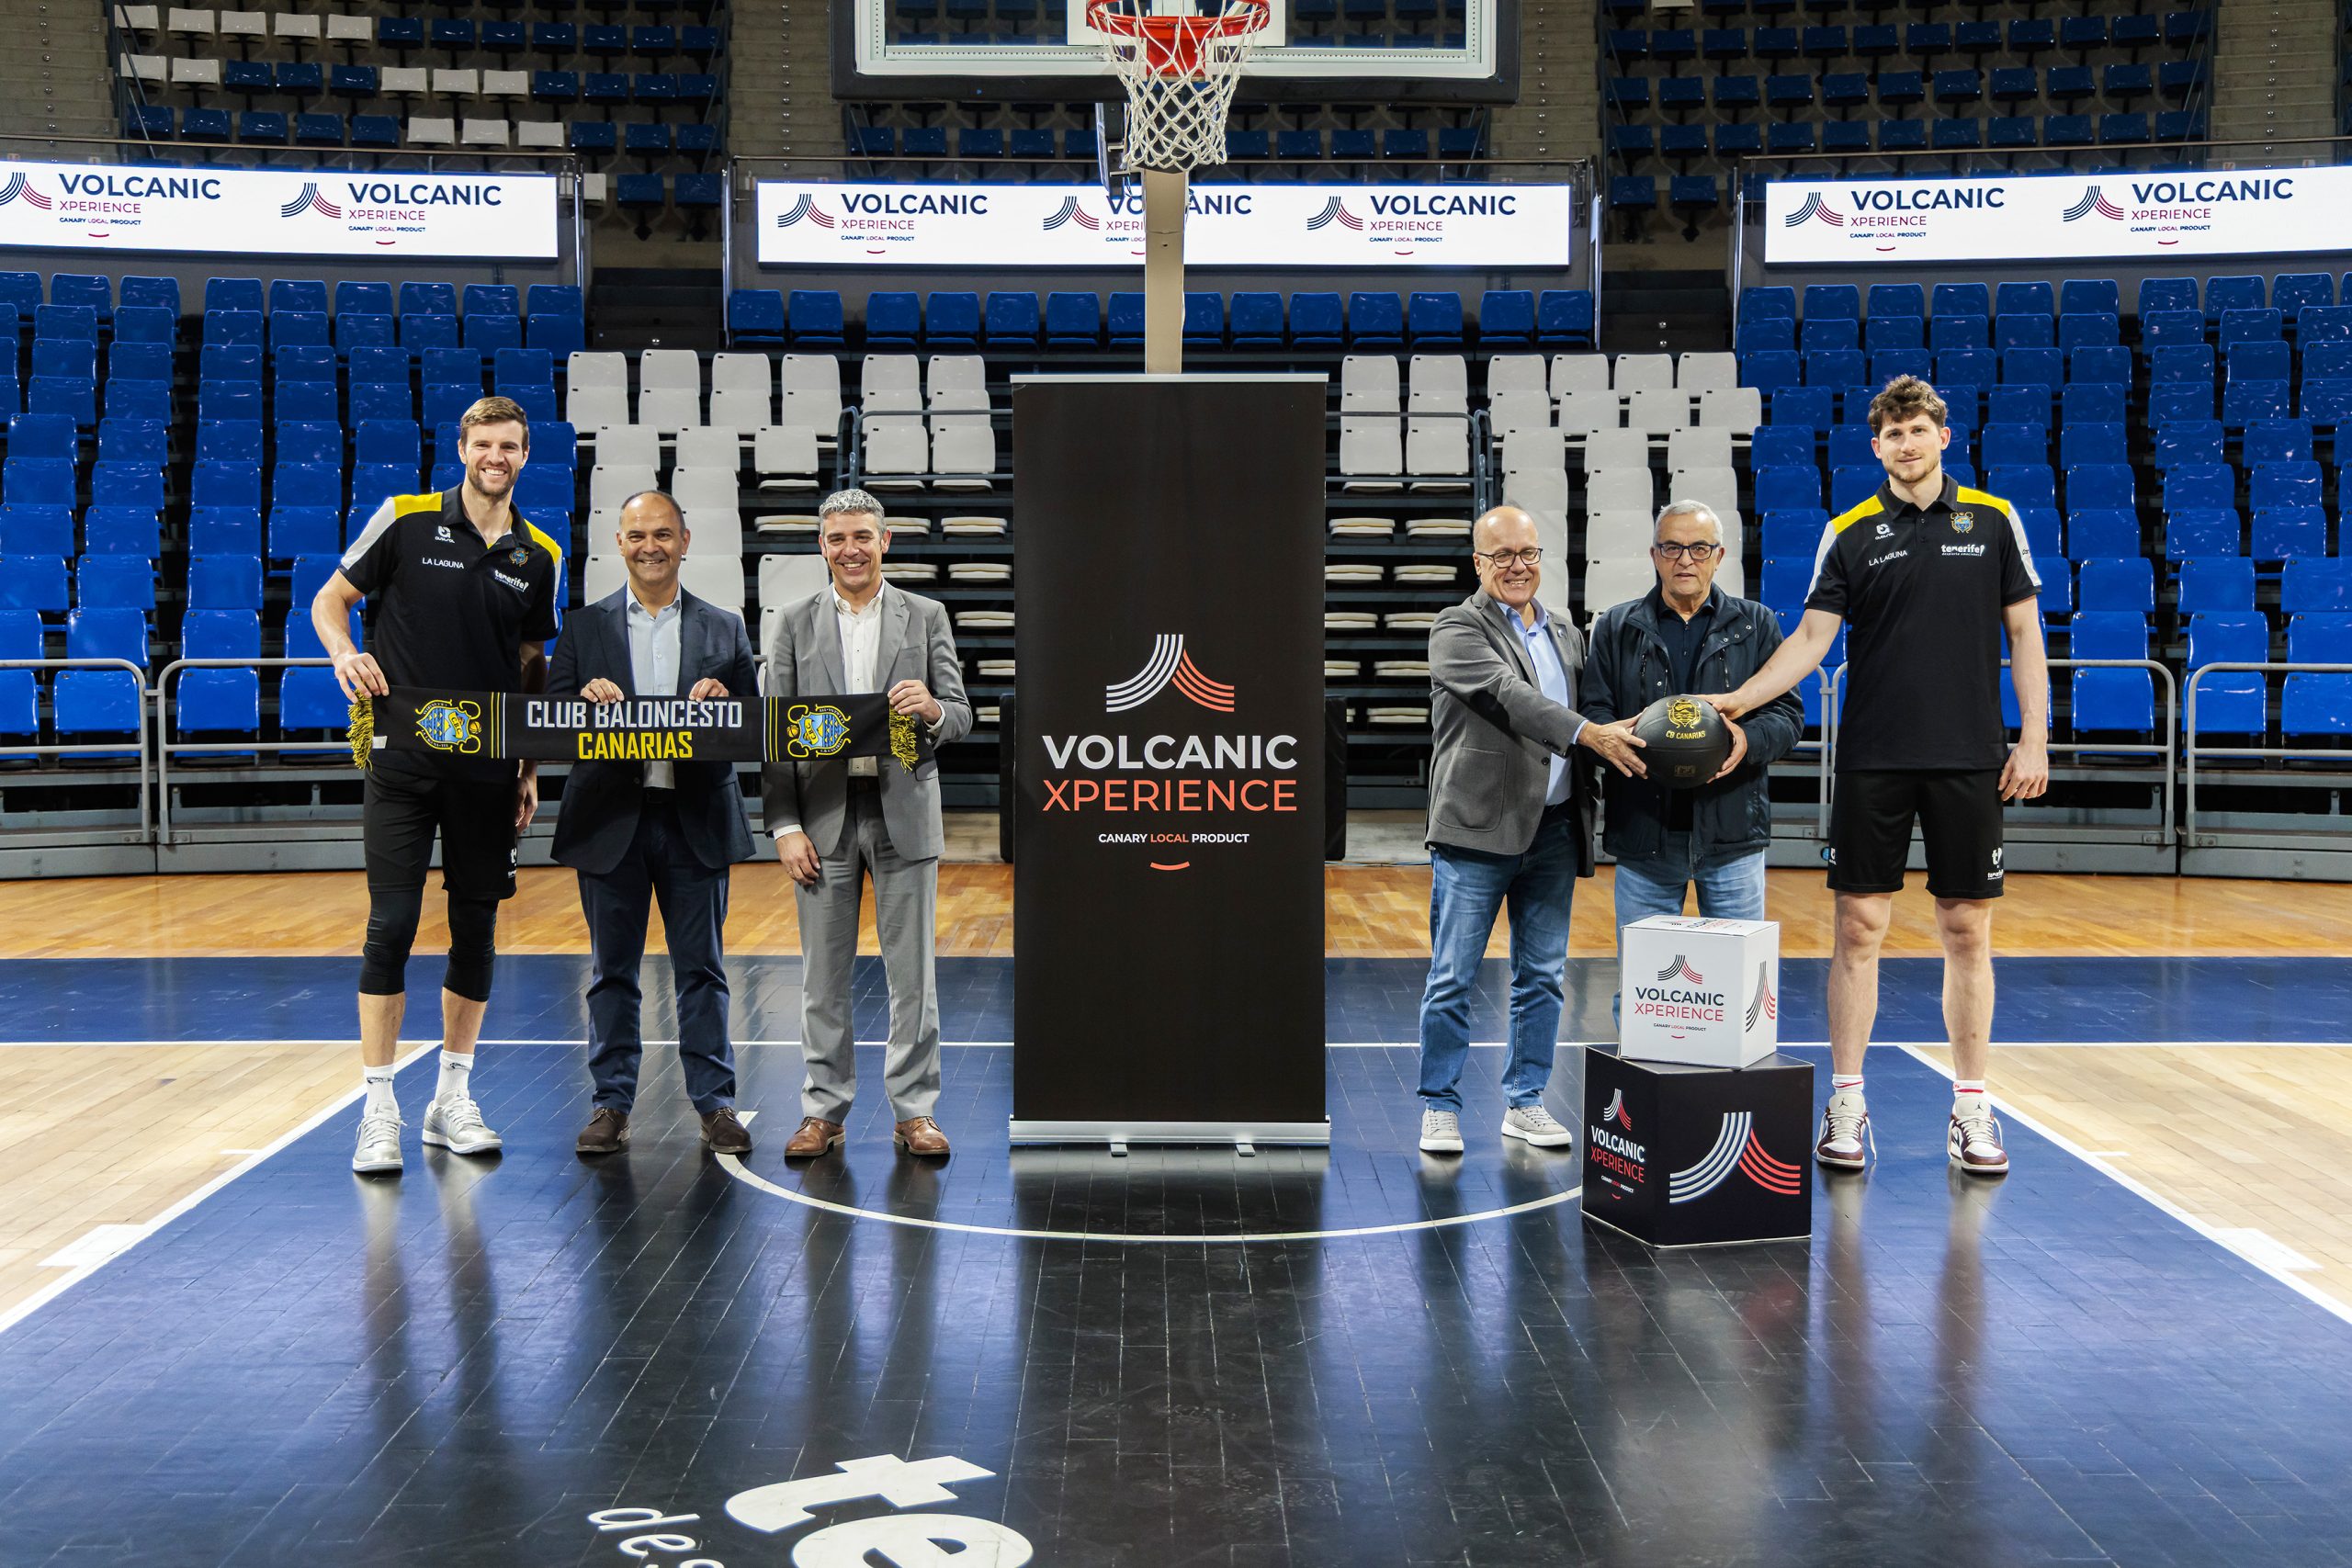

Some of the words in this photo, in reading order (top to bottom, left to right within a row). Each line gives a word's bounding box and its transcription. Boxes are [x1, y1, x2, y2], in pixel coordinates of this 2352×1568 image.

[59, 173, 221, 200] VOLCANIC
[347, 182, 502, 206] VOLCANIC
[2131, 177, 2294, 205] VOLCANIC
[60, 200, 141, 213] XPERIENCE
[841, 193, 989, 215] VOLCANIC
[1106, 194, 1252, 216] VOANIC
[1369, 195, 1517, 216] VOLCANIC
[1850, 186, 2005, 211] VOLCANIC
[348, 209, 426, 220] XPERIENCE
[1850, 216, 1927, 227] XPERIENCE
[2131, 208, 2211, 220] XPERIENCE
[841, 220, 915, 231] XPERIENCE
[1370, 220, 1443, 231] XPERIENCE
[422, 557, 433, 565] LA
[434, 558, 465, 570] LAGUNA
[1868, 558, 1880, 567] LA
[1879, 549, 1908, 563] LAGUNA
[527, 700, 587, 728] CLUB
[594, 700, 742, 728] BALONCESTO
[1666, 730, 1675, 739] CB
[1676, 730, 1706, 739] CANARIAS
[578, 731, 694, 760] CANARIAS
[1042, 734, 1298, 770] VOLCANIC
[1042, 779, 1297, 811] XPERIENCE
[1098, 833, 1148, 843] CANARY
[1150, 833, 1190, 843] LOCAL
[1192, 833, 1250, 843] PRODUCT
[1635, 987, 1724, 1007] VOLCANIC
[1634, 1002, 1724, 1021] XPERIENCE
[1590, 1124, 1646, 1163] VOLCANIC
[1590, 1145, 1645, 1183] XPERIENCE
